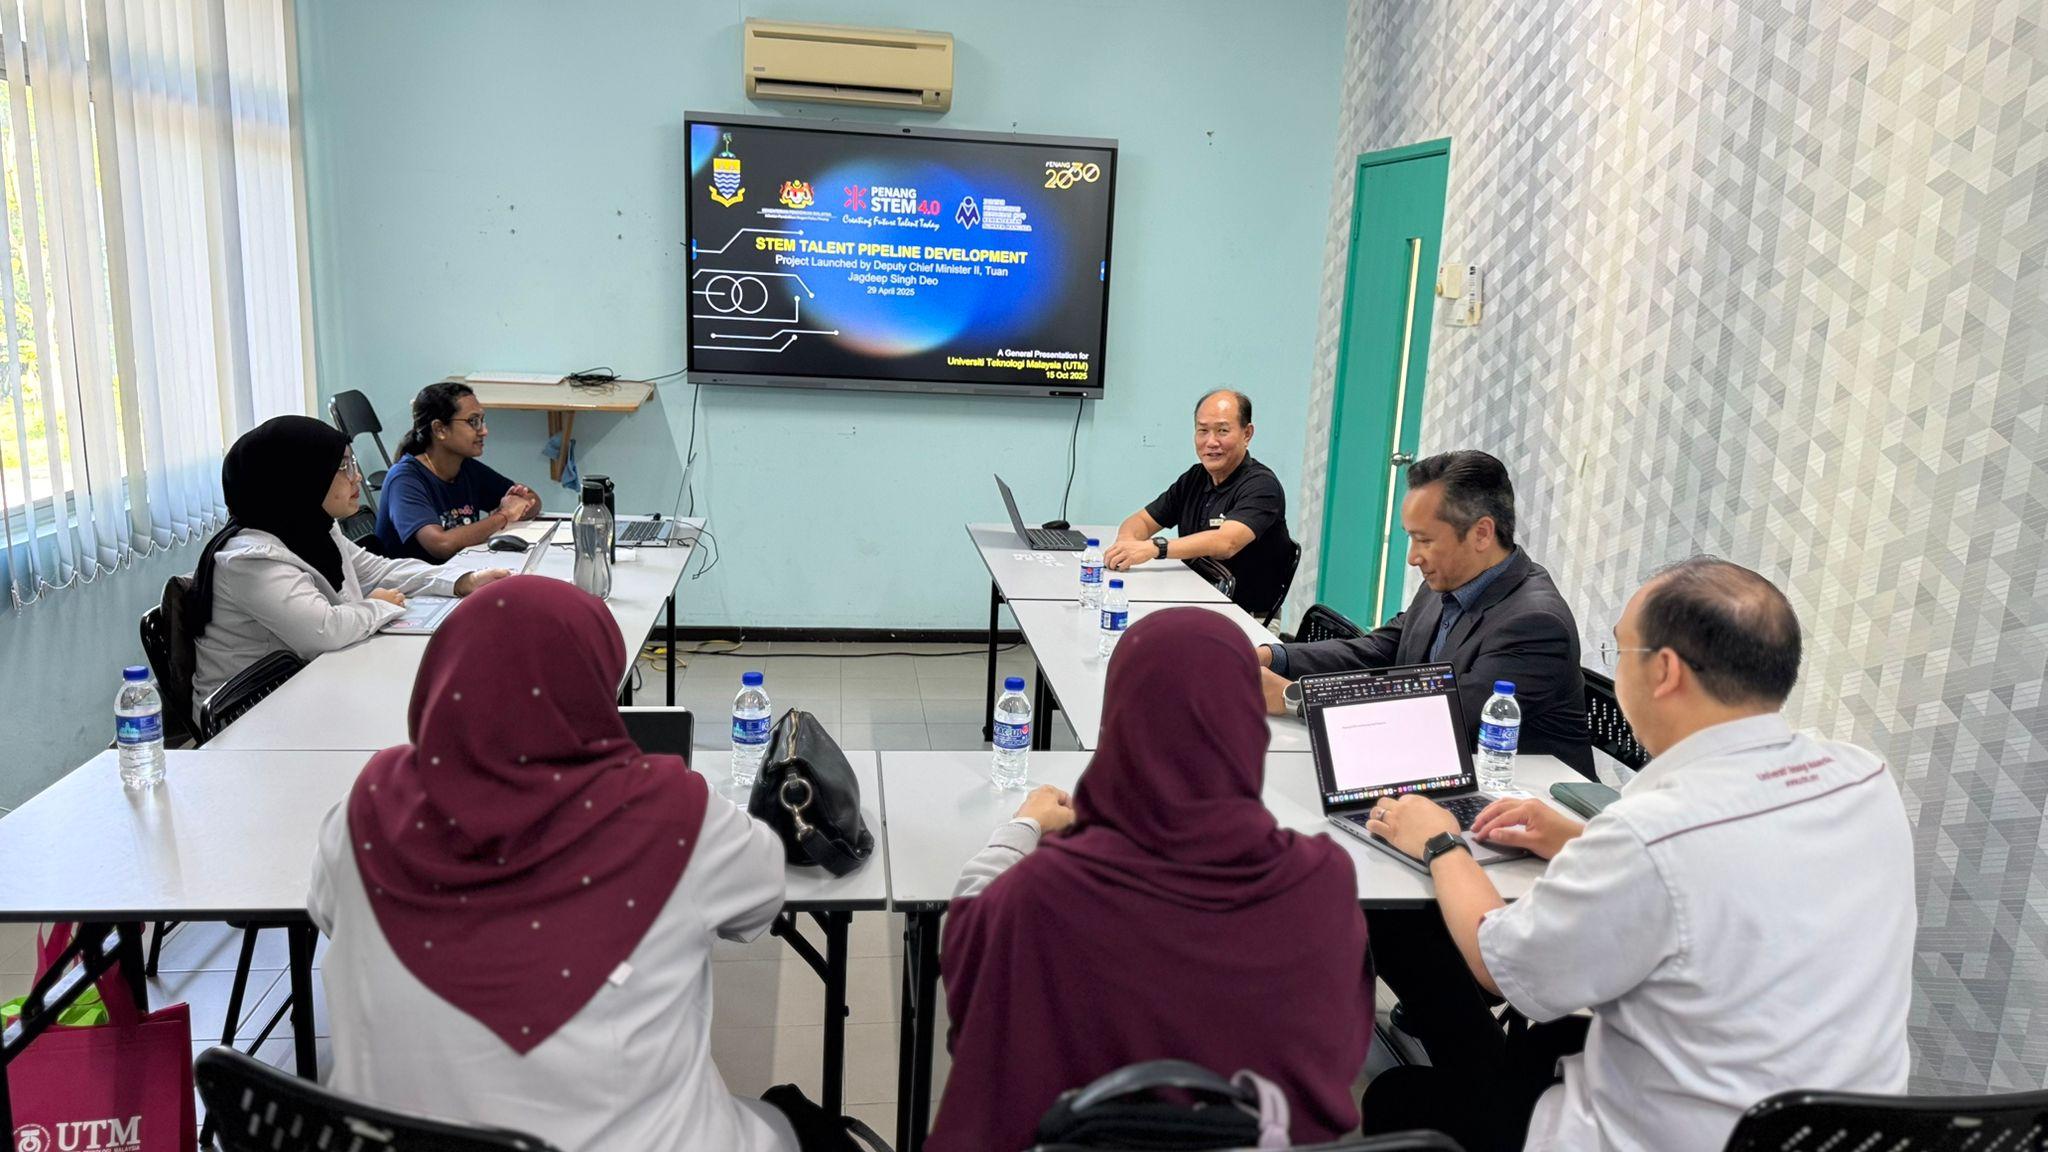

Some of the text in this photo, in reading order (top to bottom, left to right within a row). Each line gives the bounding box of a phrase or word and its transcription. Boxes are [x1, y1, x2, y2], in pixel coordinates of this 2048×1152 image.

[871, 186, 917, 199] PENANG
[871, 197, 941, 215] STEM 4.0
[842, 214, 872, 228] Creating
[873, 215, 896, 227] Future
[897, 217, 919, 228] Talent
[920, 218, 940, 232] Today
[755, 237, 1028, 264] STEM TALENT PIPELINE DEVELOPMENT
[775, 254, 809, 267] Project
[811, 257, 857, 269] Launched
[860, 259, 871, 271] by
[874, 260, 906, 273] Deputy
[909, 262, 934, 273] Chief
[935, 263, 972, 275] Minister
[985, 265, 1008, 276] Tuan
[848, 272, 939, 286] Jagdeep Singh Deo
[867, 286, 915, 296] 29 April 2025
[997, 349, 1089, 360] A General Presentation for
[947, 356, 1089, 371] Universiti Teknologi Malaysia (UTM)
[1046, 371, 1088, 380] 15 Oct 2025
[56, 1116, 142, 1151] UTM
